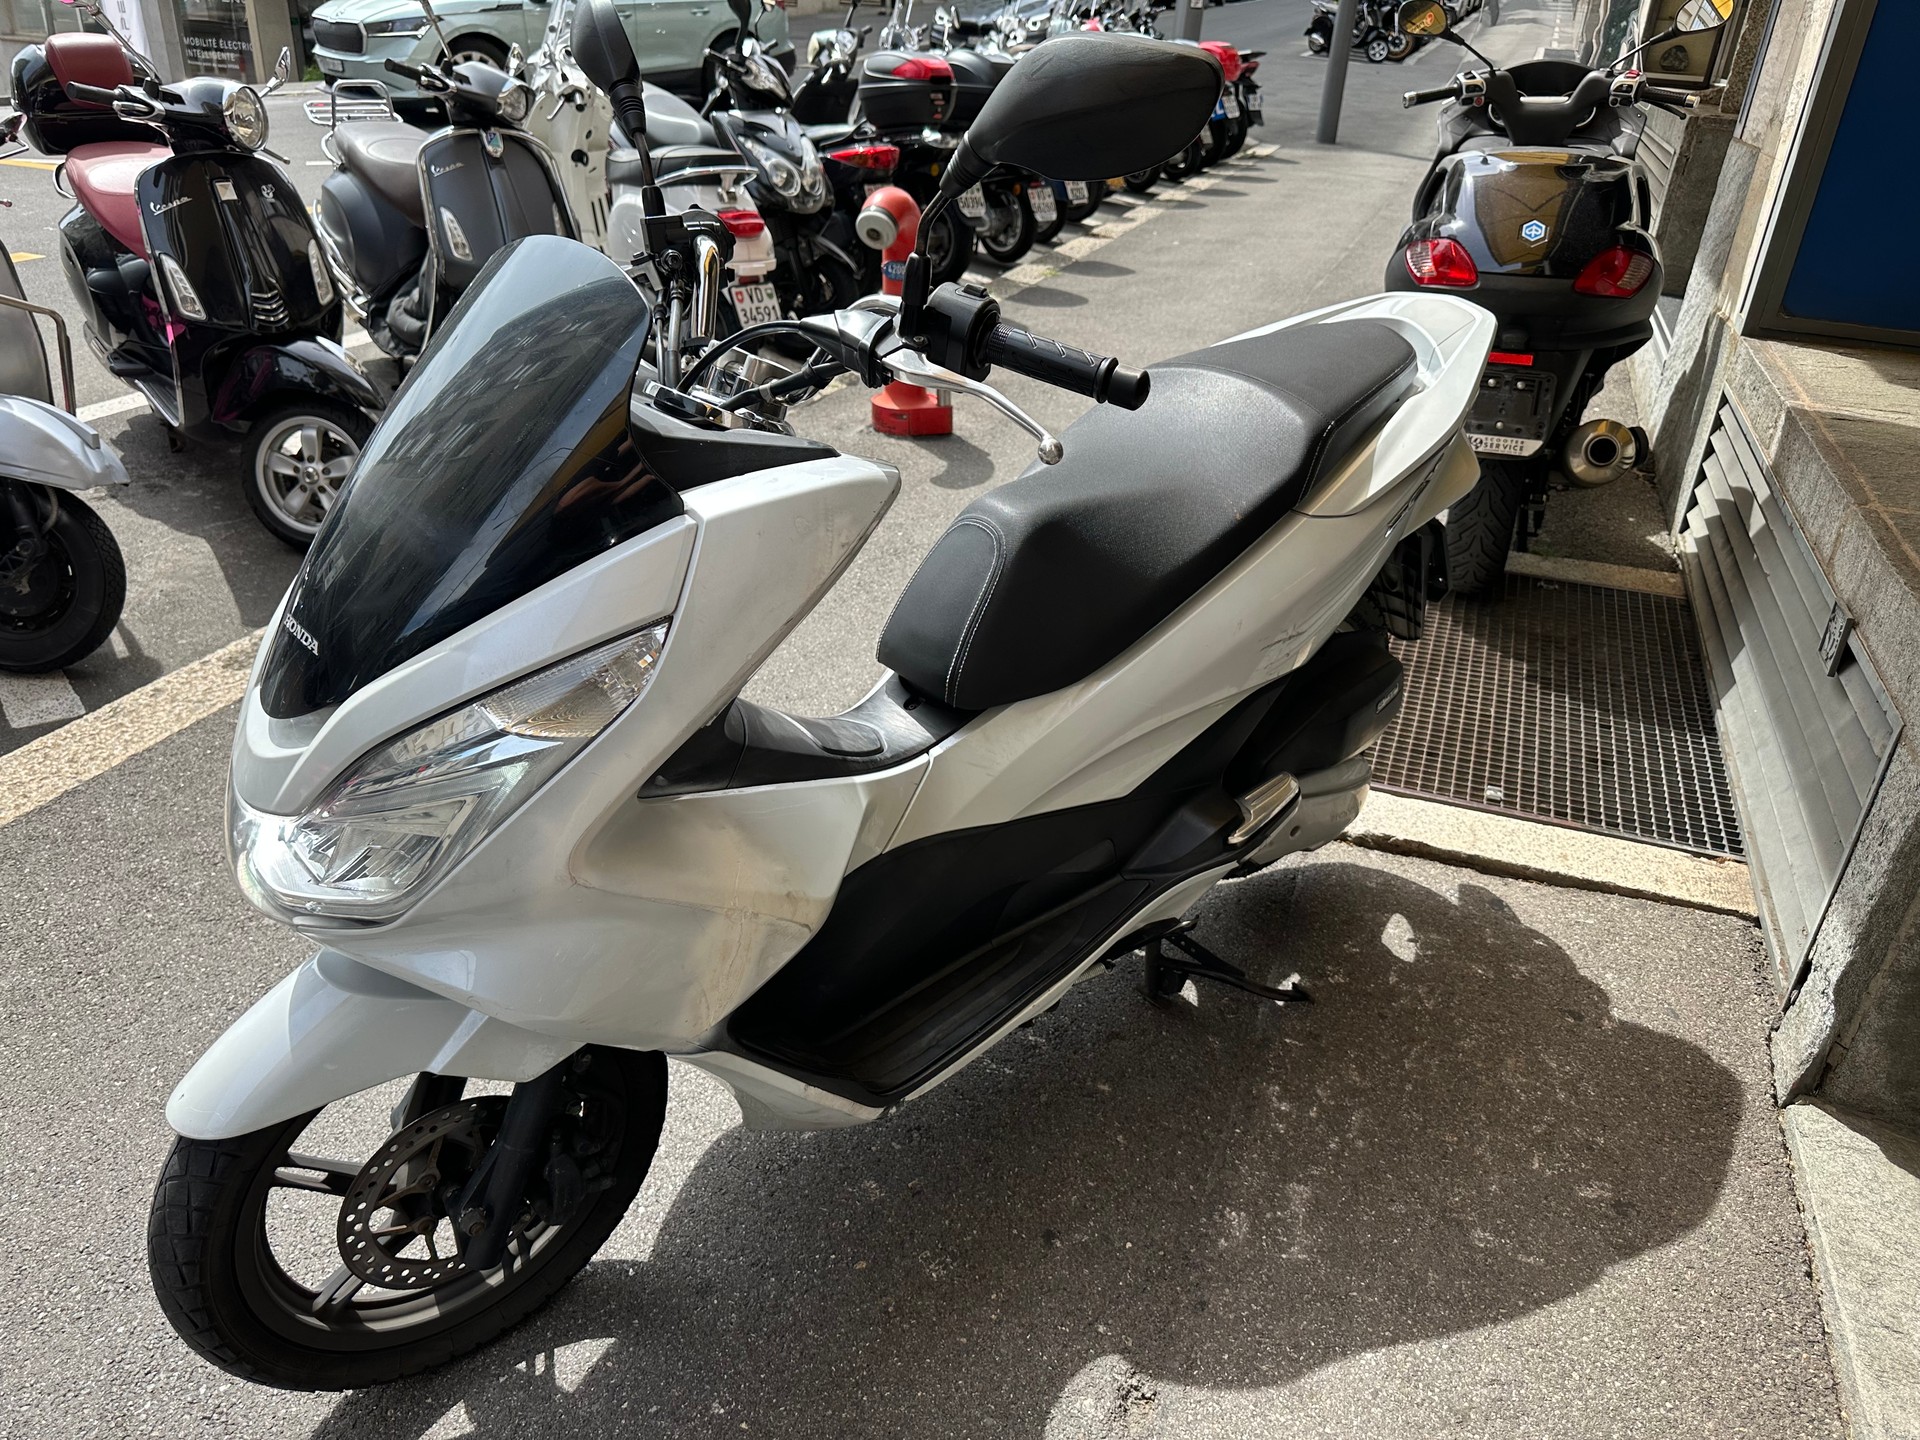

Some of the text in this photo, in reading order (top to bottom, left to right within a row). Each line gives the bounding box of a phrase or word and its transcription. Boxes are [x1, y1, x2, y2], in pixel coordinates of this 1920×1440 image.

[184, 36, 217, 48] MOBILITÉ
[149, 196, 192, 215] Vespa
[746, 287, 764, 304] VD
[740, 305, 779, 324] 34591
[1483, 442, 1525, 452] SERVICE
[283, 613, 319, 656] HONDA
